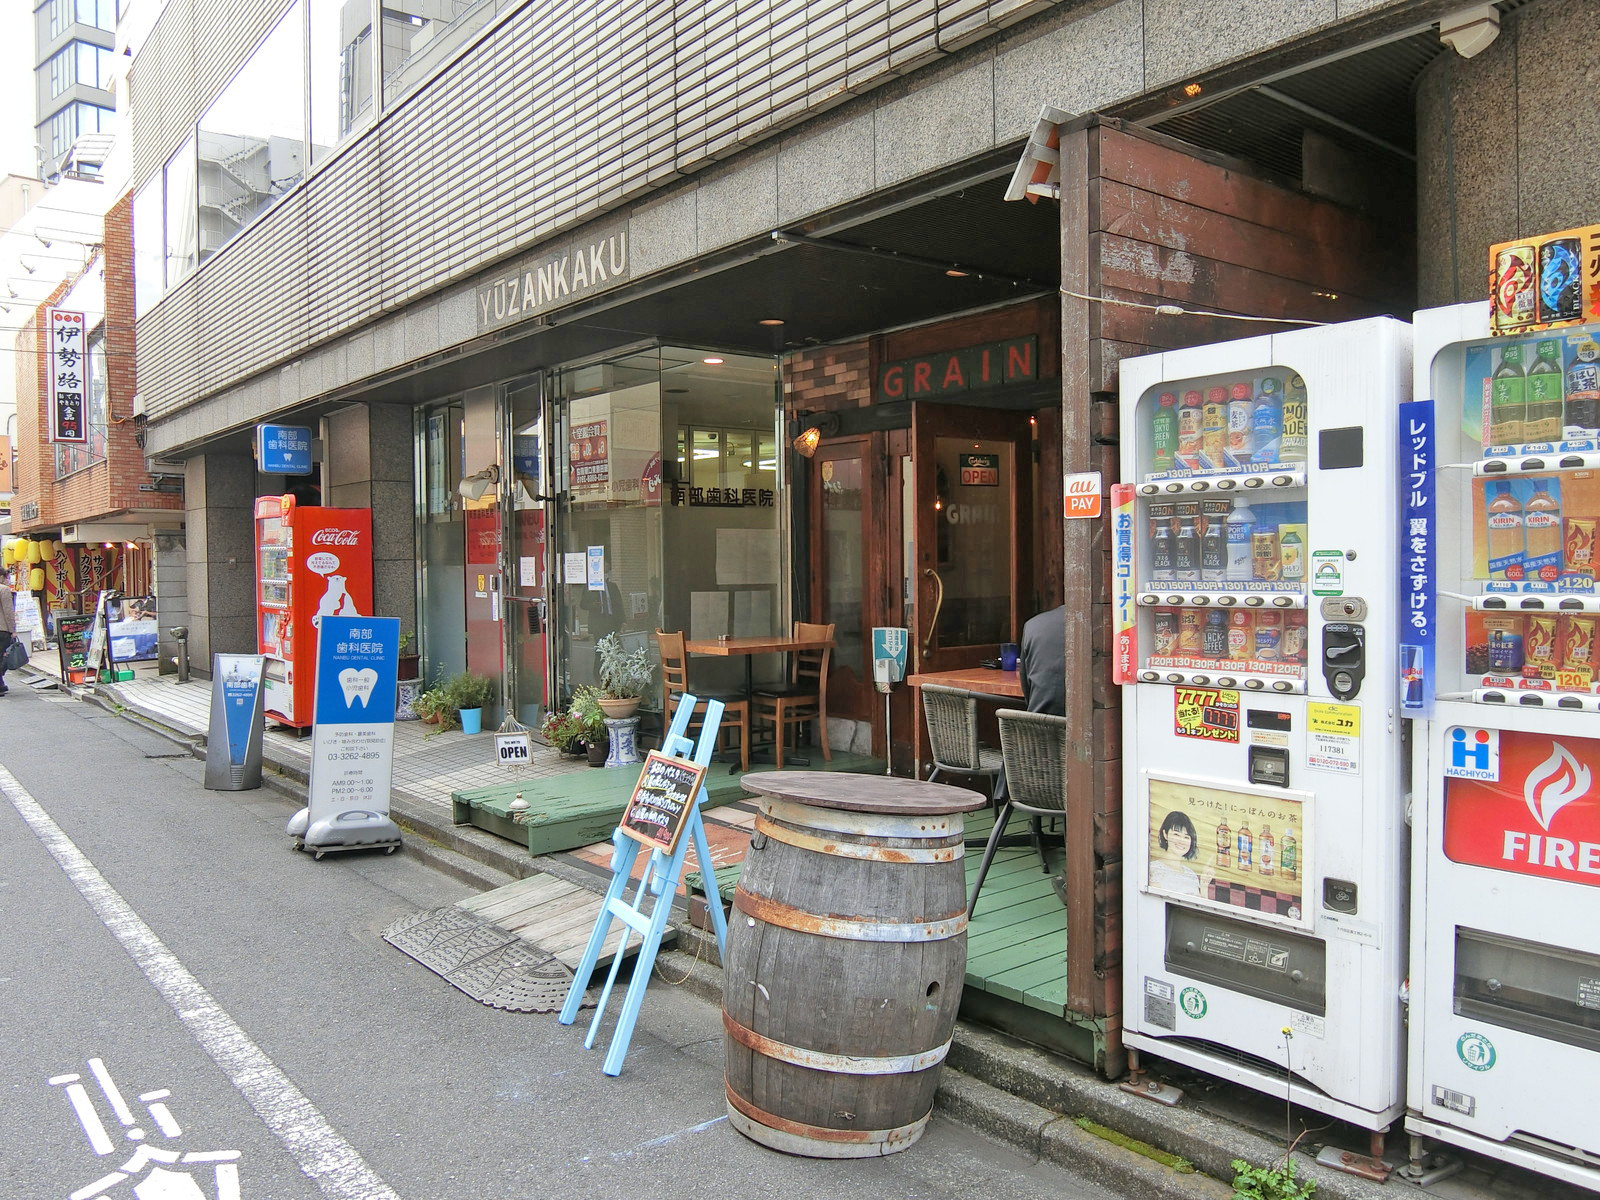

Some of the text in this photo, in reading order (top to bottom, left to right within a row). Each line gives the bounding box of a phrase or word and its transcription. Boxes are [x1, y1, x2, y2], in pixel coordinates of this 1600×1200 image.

[1572, 275, 1580, 310] BLACK
[57, 325, 82, 389] 伊勢路
[884, 343, 1030, 397] GRAIN
[1498, 383, 1509, 402] 生茶
[1534, 379, 1545, 399] 生茶
[62, 421, 77, 430] 95
[65, 429, 75, 437] 円
[278, 430, 298, 440] 南部
[268, 440, 308, 451] 歯科医院
[1167, 468, 1192, 478] 130円
[1242, 462, 1269, 473] 110円
[962, 470, 997, 484] OPEN
[1070, 480, 1096, 493] au
[670, 487, 774, 507] 南部歯科医院
[1071, 497, 1094, 510] PAY
[1409, 419, 1428, 636] レッドブル 翼をさずける。
[312, 529, 360, 546] Coca-Cola
[1489, 558, 1522, 569] 国産天然水
[1523, 557, 1557, 568] 国産天然水
[55, 550, 69, 600] ハイボール
[1168, 582, 1192, 590] 150円
[1193, 582, 1217, 590] 150円
[1273, 582, 1300, 591] 130円
[1559, 577, 1592, 588] ¥120
[1117, 513, 1132, 676] お買得コーナー あります。
[349, 628, 372, 640] 南部
[336, 642, 384, 654] 歯科医院
[1151, 657, 1173, 666] 120円
[1191, 659, 1215, 669] 130円
[1221, 661, 1246, 671] 130円
[1273, 664, 1300, 675] 120円
[226, 681, 255, 689] 南部歯科
[1558, 674, 1589, 686] 120円
[1176, 688, 1218, 706] 7777
[1222, 691, 1237, 699] LUCKY
[1206, 709, 1236, 727] 7777
[1336, 718, 1354, 728] ユカ
[500, 746, 528, 759] OPEN
[1320, 745, 1344, 754] 117381
[328, 752, 380, 760] 03-3262-4895
[1447, 768, 1494, 779] HACHIYOH
[1187, 797, 1297, 823] 見つけた!にっぽんのお茶
[1502, 830, 1600, 875] FIRE
